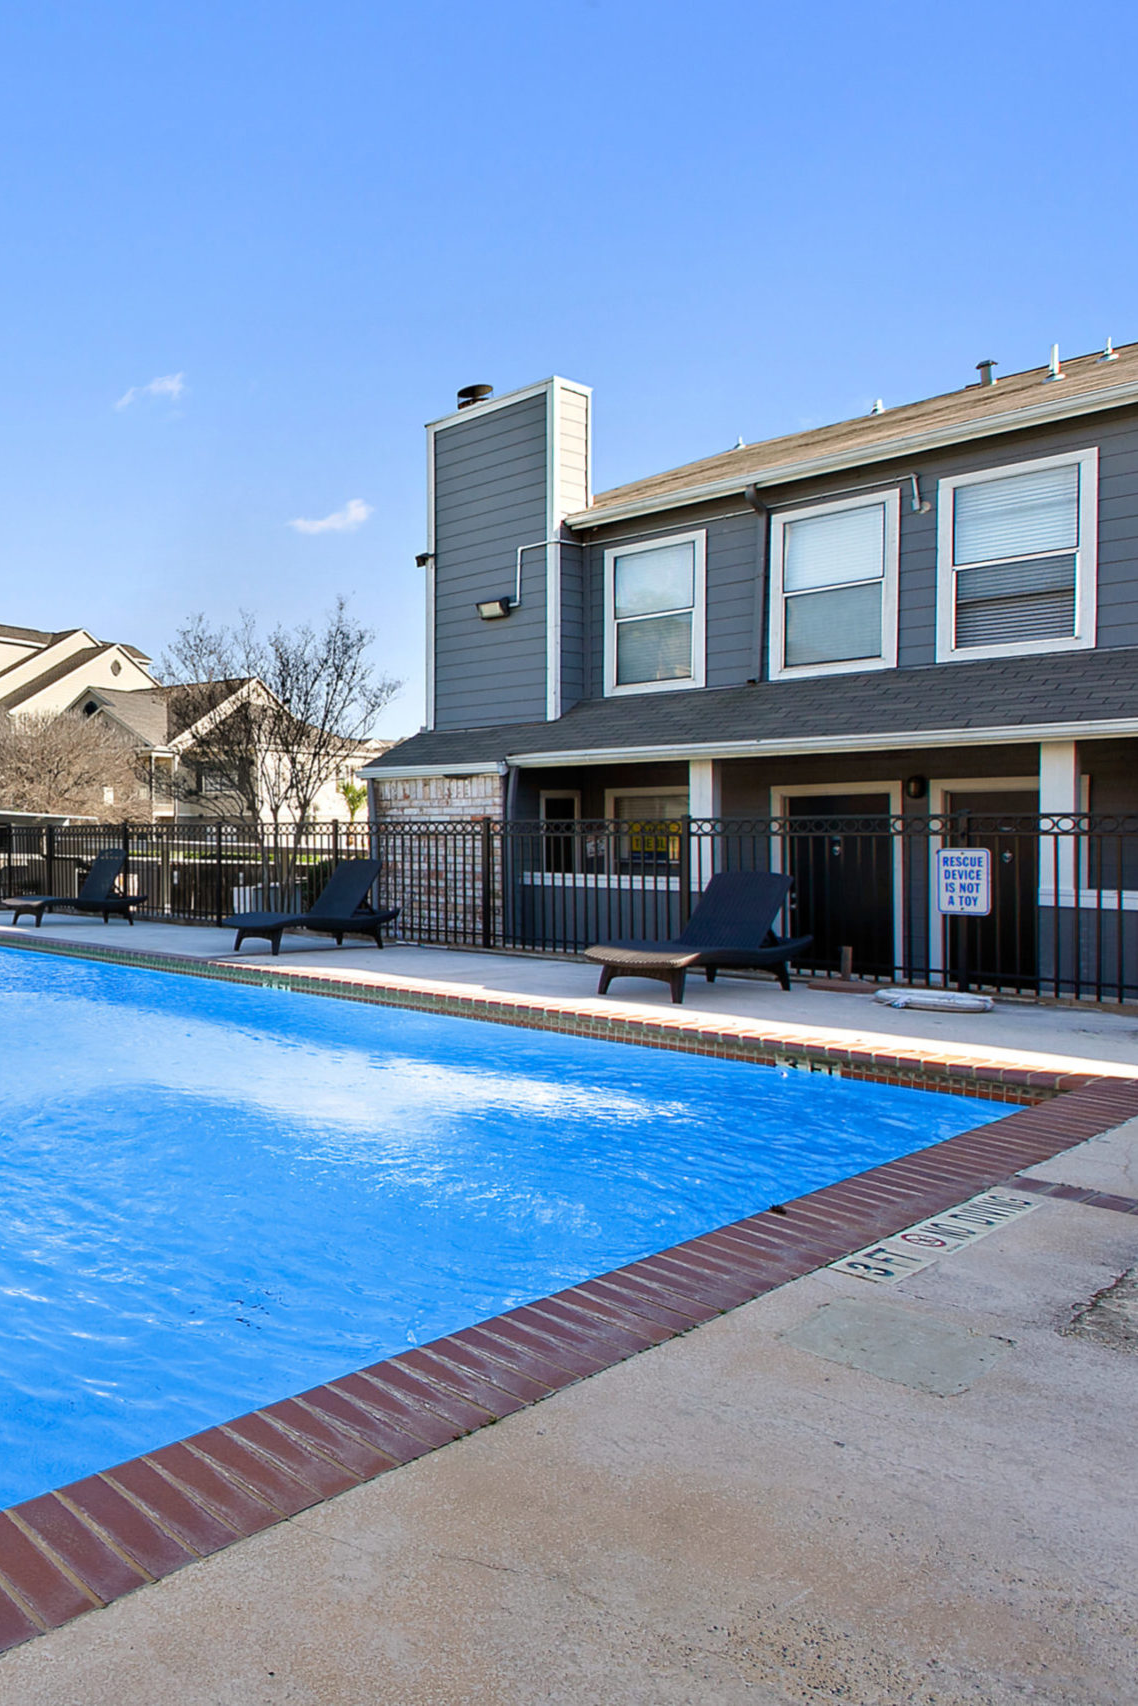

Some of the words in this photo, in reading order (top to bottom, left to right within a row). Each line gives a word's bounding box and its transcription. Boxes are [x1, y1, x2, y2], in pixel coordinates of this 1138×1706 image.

[942, 856, 983, 867] RESCUE
[944, 869, 982, 880] DEVICE
[945, 882, 956, 893] IS
[959, 882, 980, 893] NOT
[948, 895, 955, 906] A
[958, 896, 978, 906] TOY
[919, 1222, 976, 1241] NO
[948, 1195, 1031, 1226] DIVING
[863, 1247, 922, 1268] FT
[846, 1261, 894, 1277] 3
